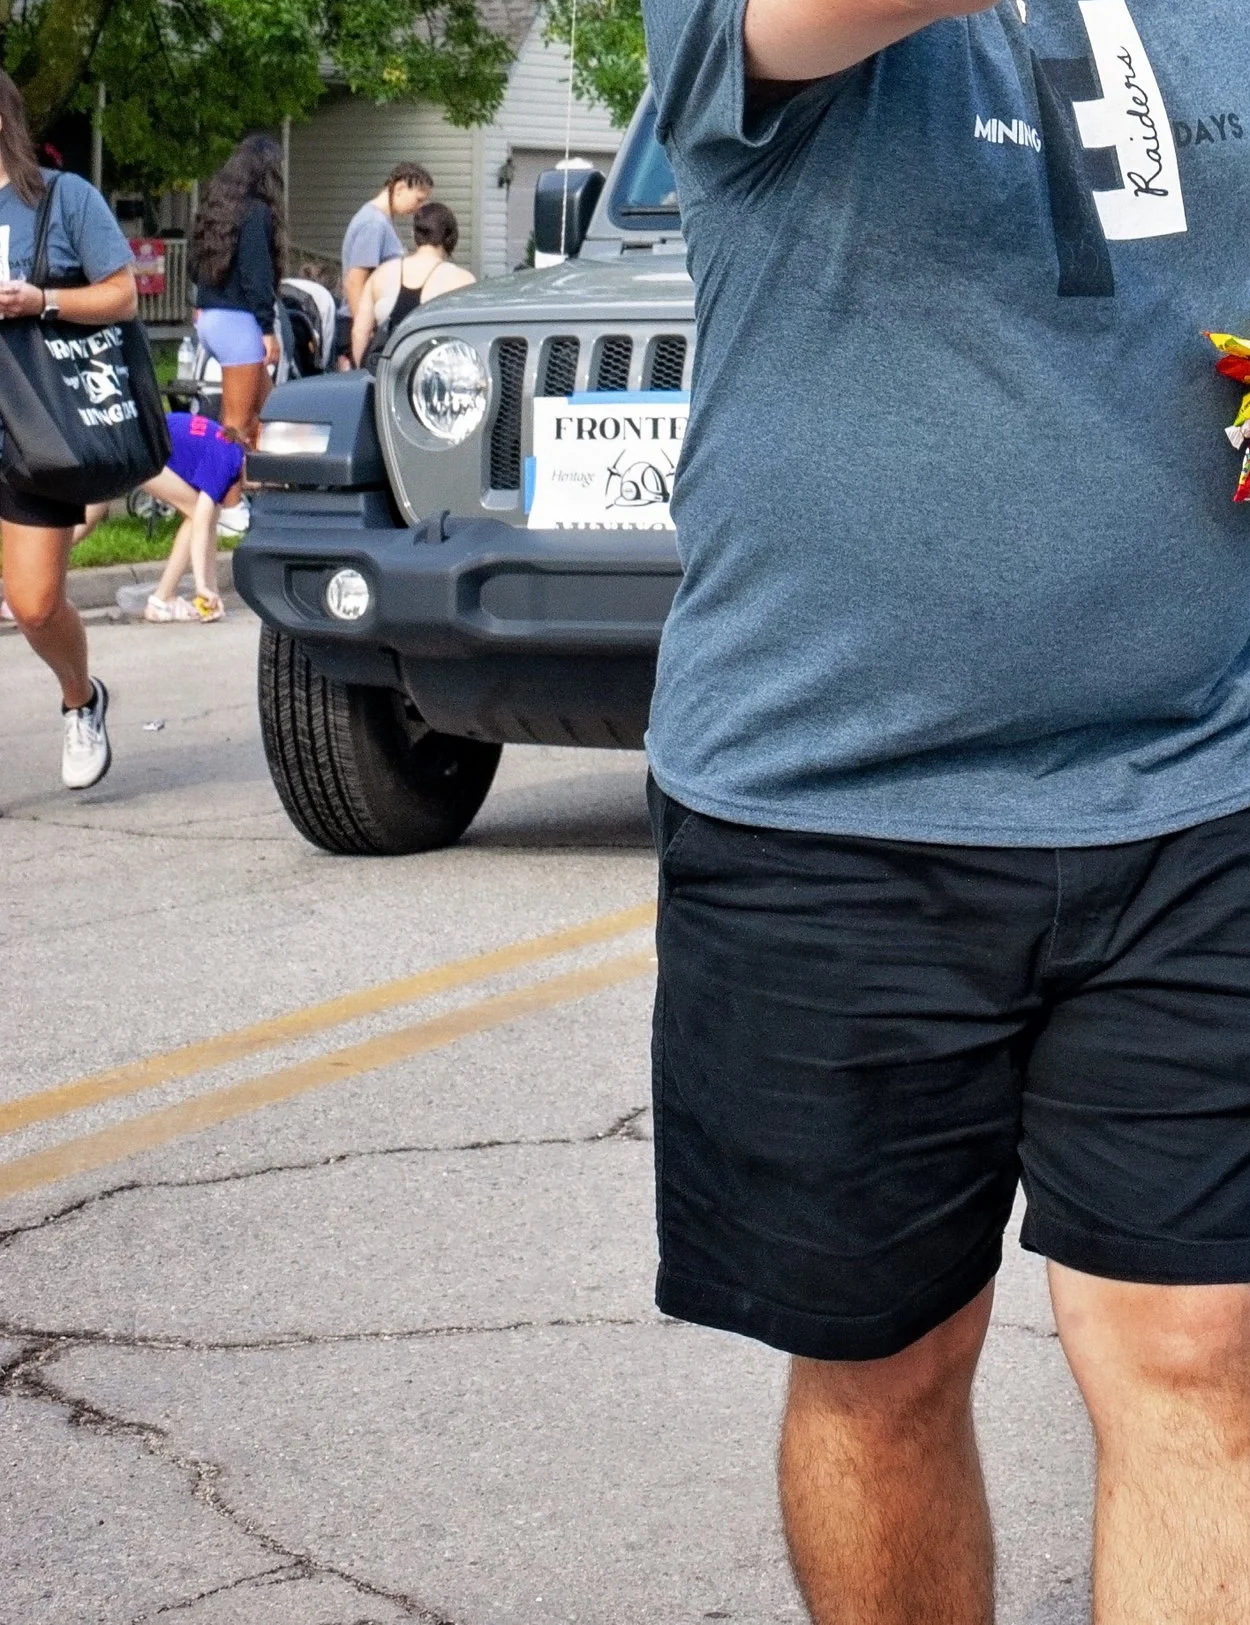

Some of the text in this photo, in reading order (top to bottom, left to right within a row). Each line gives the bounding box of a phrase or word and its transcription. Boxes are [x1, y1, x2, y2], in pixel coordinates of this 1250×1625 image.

[973, 114, 1043, 154] MINING
[1174, 112, 1244, 149] DAYS
[1117, 45, 1169, 198] Raiders
[555, 417, 688, 440] FRONTE
[551, 469, 595, 488] Heritage
